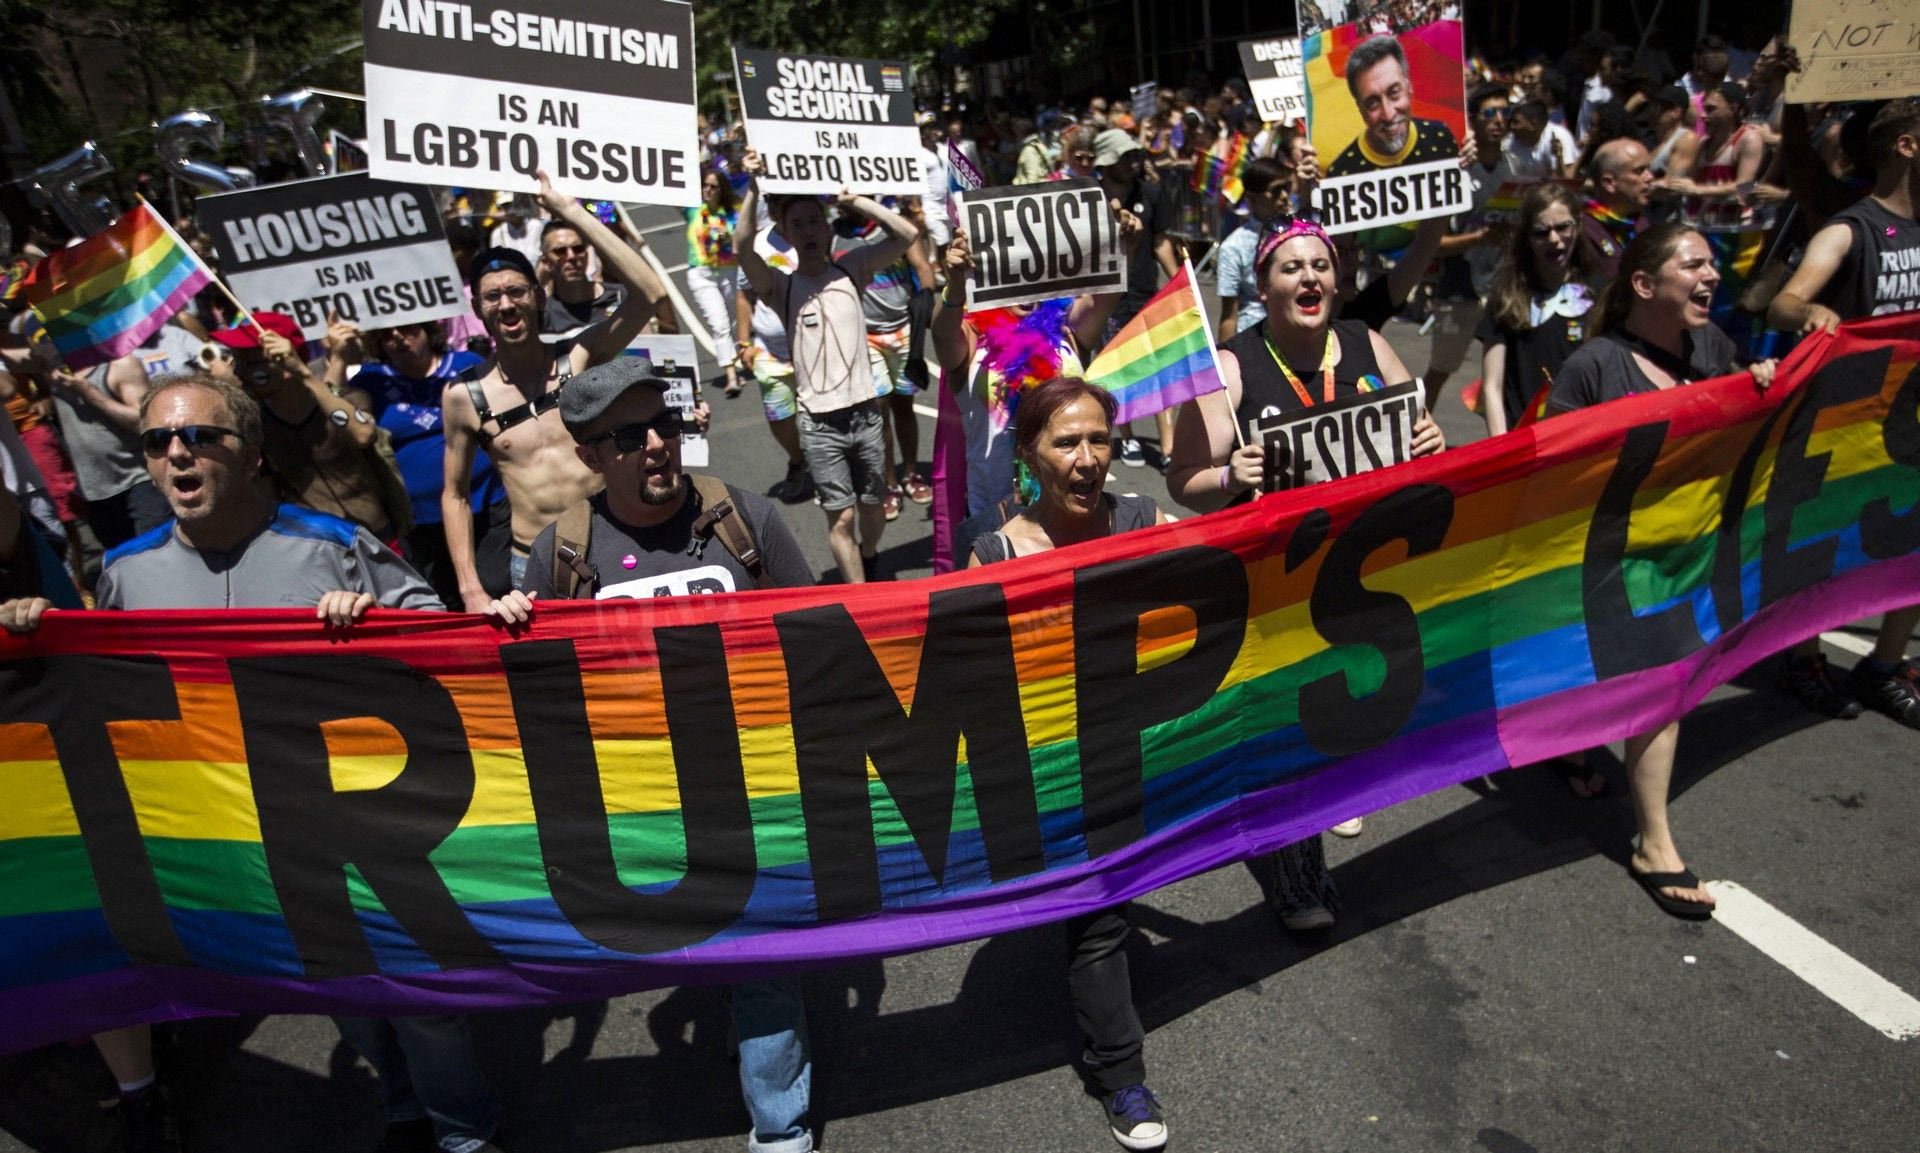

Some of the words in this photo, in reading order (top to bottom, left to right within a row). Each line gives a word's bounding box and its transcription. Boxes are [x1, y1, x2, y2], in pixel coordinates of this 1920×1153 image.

[378, 0, 679, 69] ANTI-SEMITISM
[1812, 23, 1894, 50] NOT
[776, 57, 874, 93] SOCIAL
[498, 93, 528, 123] IS
[537, 98, 580, 129] AN
[766, 86, 891, 122] SECURITY
[383, 118, 540, 181] LGBTQ
[556, 138, 686, 189] ISSUE
[815, 131, 832, 149] IS
[838, 132, 859, 150] AN
[761, 153, 844, 184] LGBTQ
[850, 156, 921, 183] ISSUE
[1321, 167, 1464, 227] RESISTER
[224, 192, 427, 263] HOUSING
[967, 191, 1117, 288] RESIST!
[315, 266, 340, 288] IS
[344, 260, 375, 284] AN
[1875, 270, 1920, 300] MAK
[362, 276, 459, 317] ISSUE
[0, 483, 1455, 977] TRUMP'S
